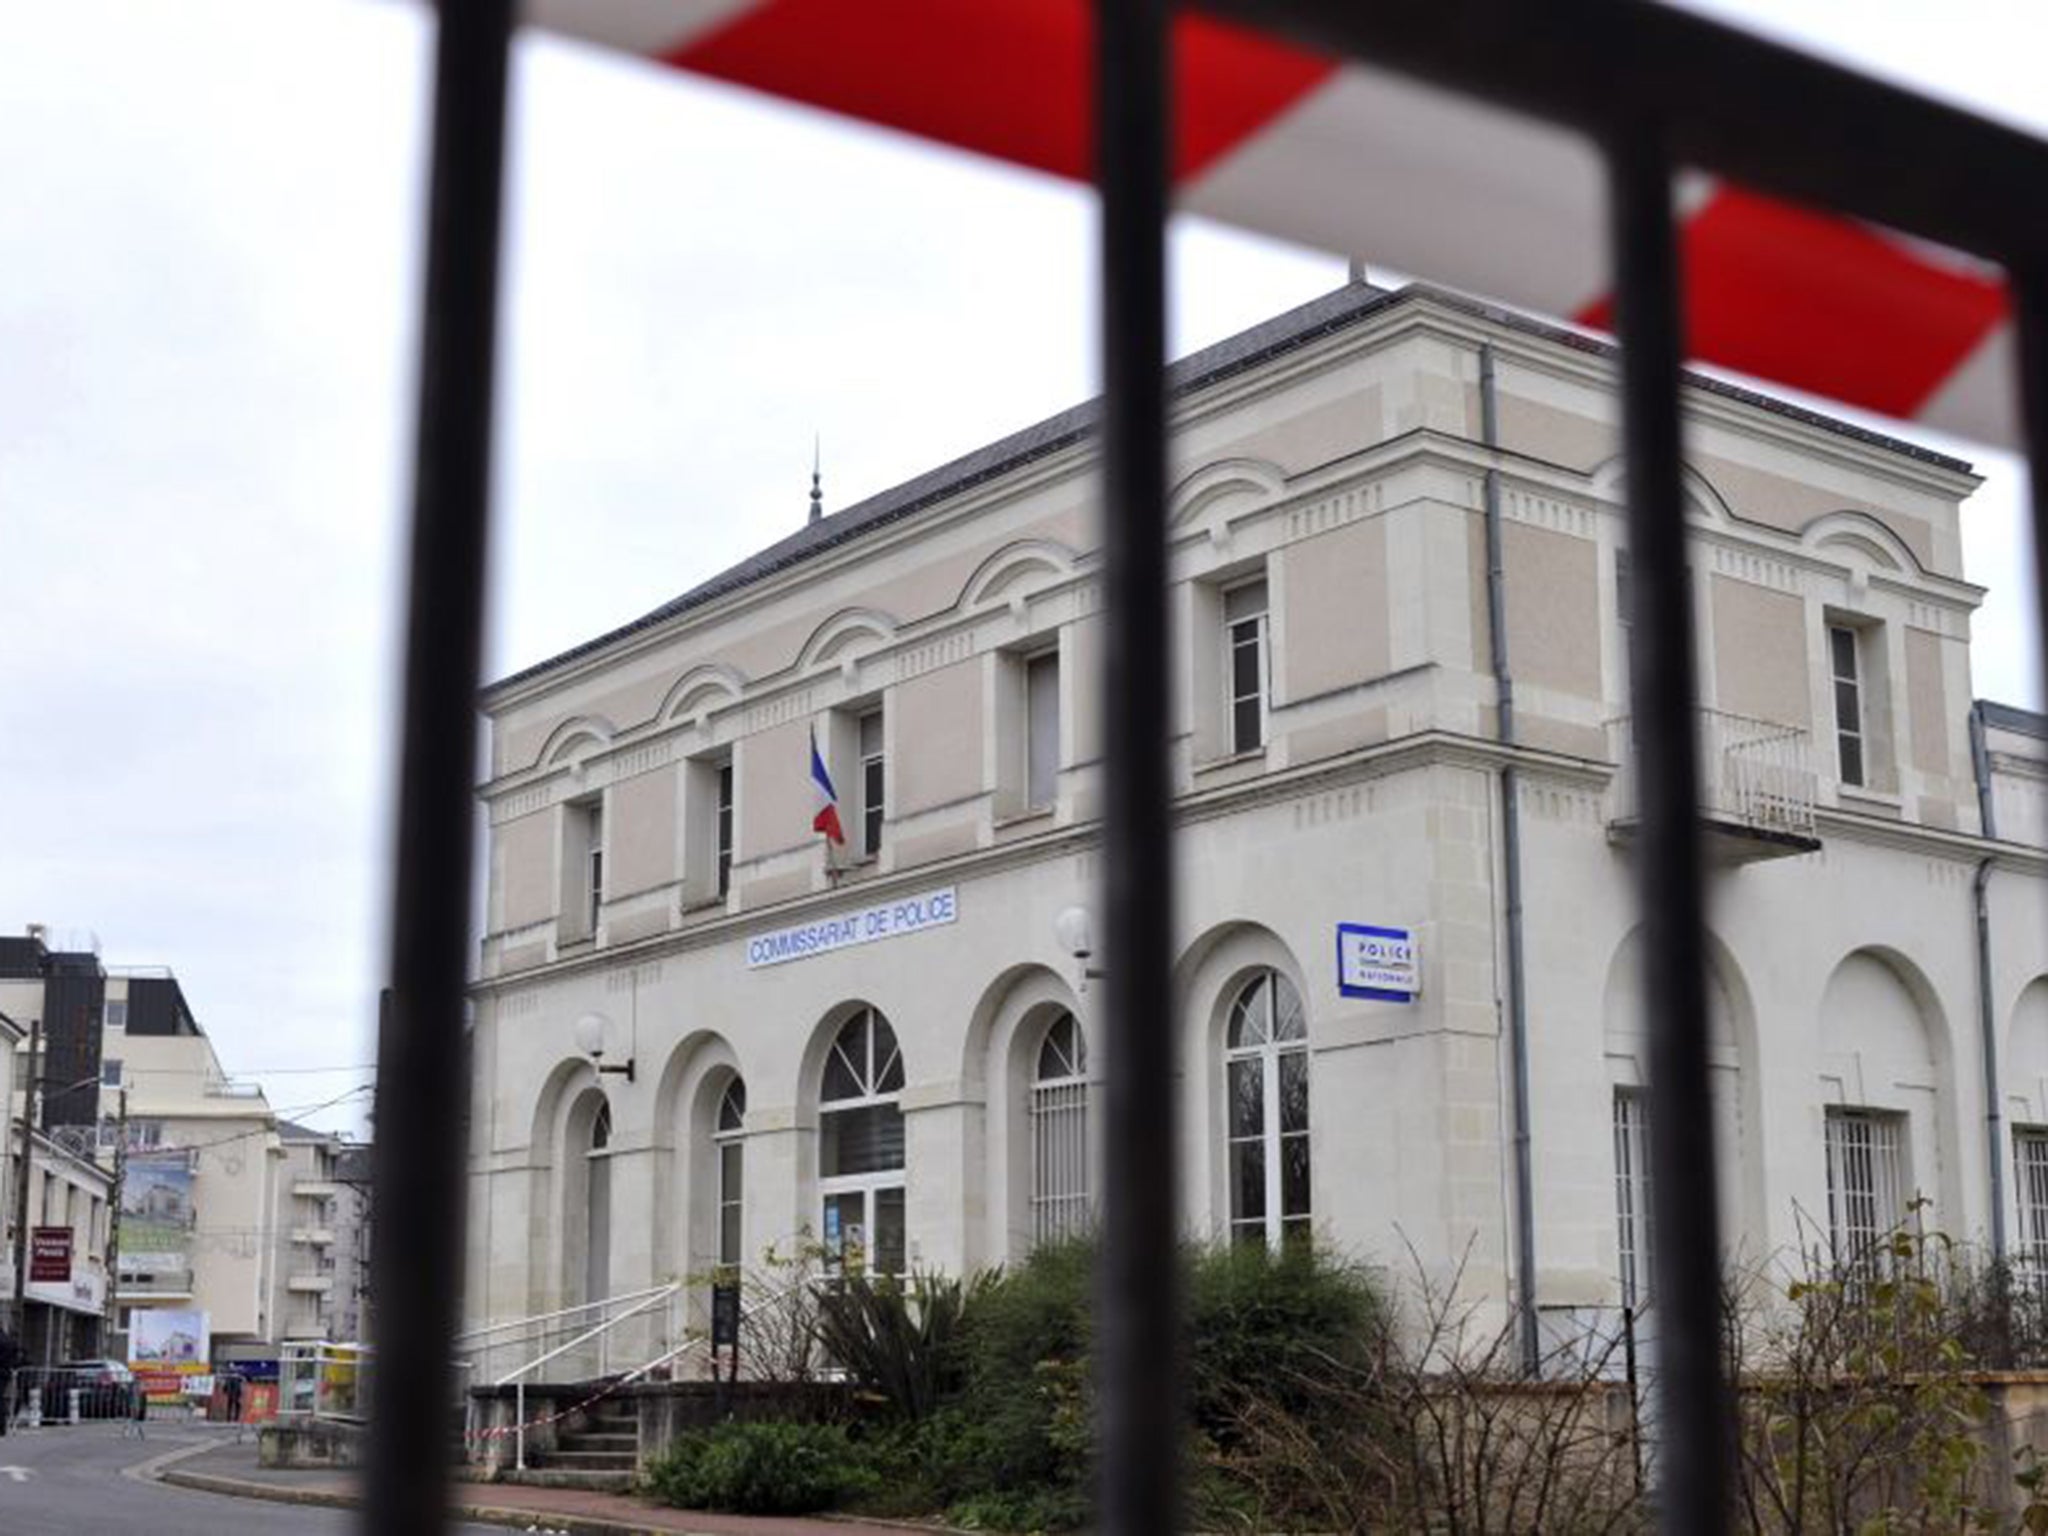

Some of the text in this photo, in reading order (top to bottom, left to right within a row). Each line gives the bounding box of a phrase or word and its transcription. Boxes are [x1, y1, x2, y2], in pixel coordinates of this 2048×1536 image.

[751, 895, 953, 963] COMMISSARIAT DE POLICE
